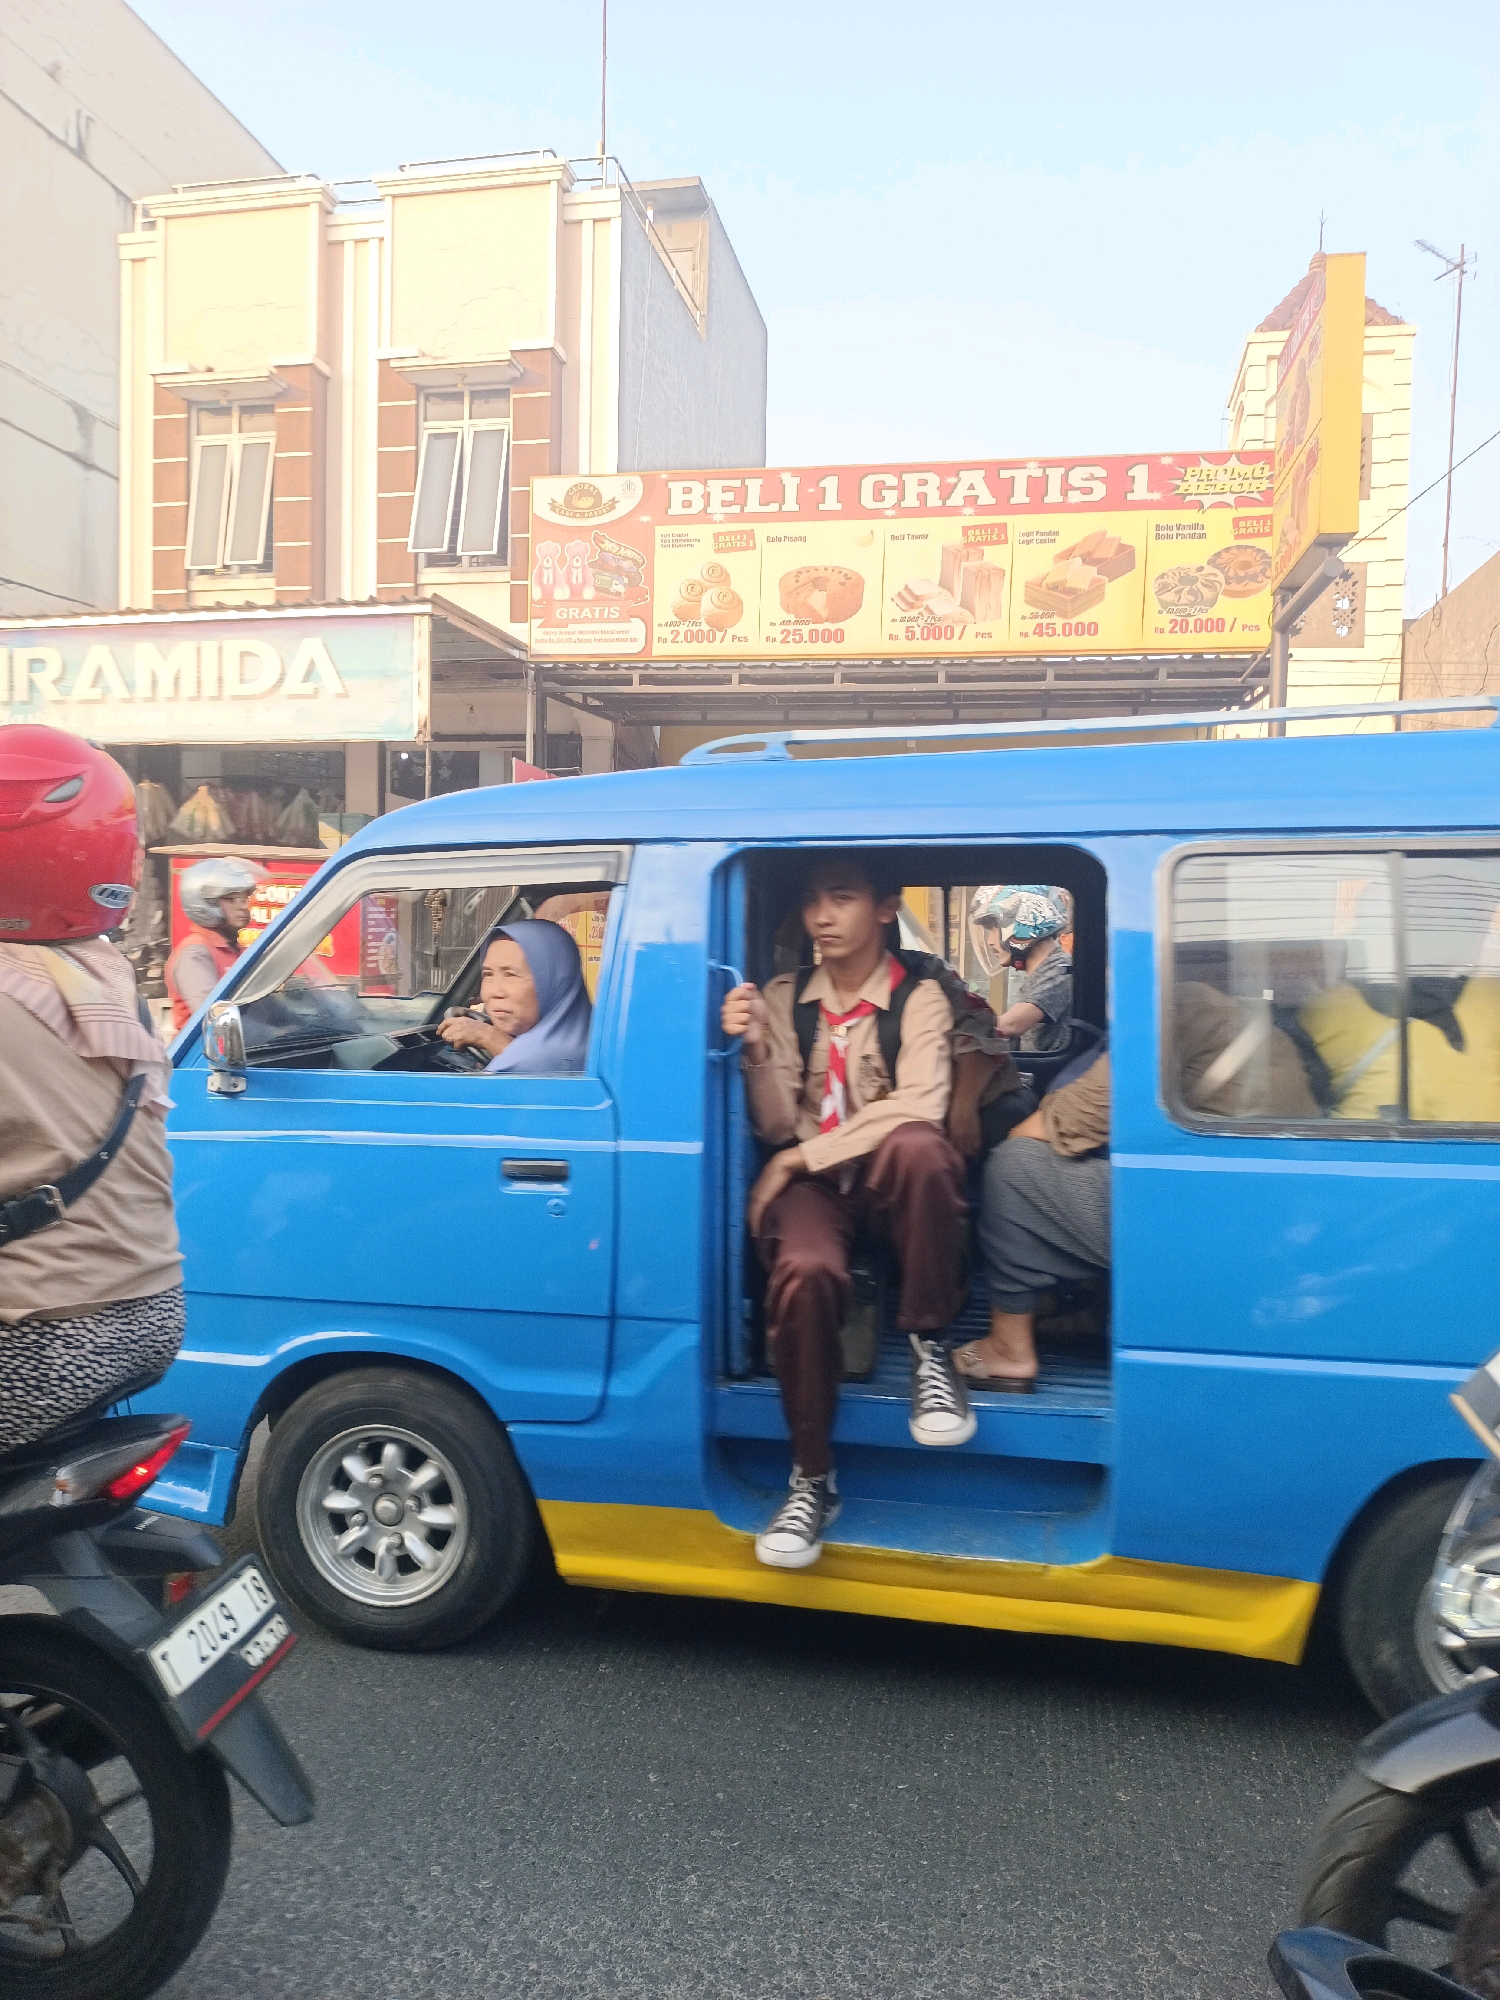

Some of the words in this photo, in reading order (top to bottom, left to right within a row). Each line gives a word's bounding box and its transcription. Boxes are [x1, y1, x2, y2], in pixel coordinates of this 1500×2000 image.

[1182, 465, 1270, 482] PROMO
[568, 483, 598, 496] GLOBAL
[667, 475, 801, 516] BELI
[817, 474, 843, 512] 1
[859, 464, 1108, 511] GRATIS
[1124, 463, 1158, 502] 1
[584, 506, 610, 517] BAKERY
[1155, 523, 1174, 532] Bolu
[1175, 522, 1205, 532] Vanilla
[1238, 520, 1263, 528] BELI
[967, 528, 991, 537] BELI
[1155, 532, 1174, 541] Bolu
[1175, 531, 1207, 541] Pandan
[1230, 526, 1271, 536] GRATIS
[719, 534, 740, 543] BELI
[783, 534, 807, 544] Pisang
[907, 533, 929, 541] Tawar
[961, 534, 998, 544] GRATIS
[712, 540, 747, 550] GRATIS
[555, 606, 620, 620] GRATIS
[1032, 621, 1099, 638] 45.000
[1168, 617, 1226, 634] 20.000
[1241, 624, 1261, 632] Pcs
[670, 629, 717, 644] 2.000
[731, 634, 749, 643] Pcs
[779, 628, 845, 644] 25.000
[904, 625, 955, 641] 5.000
[975, 631, 993, 639] Pcs
[159, 1650, 183, 1687] T
[187, 1601, 240, 1664] 2049
